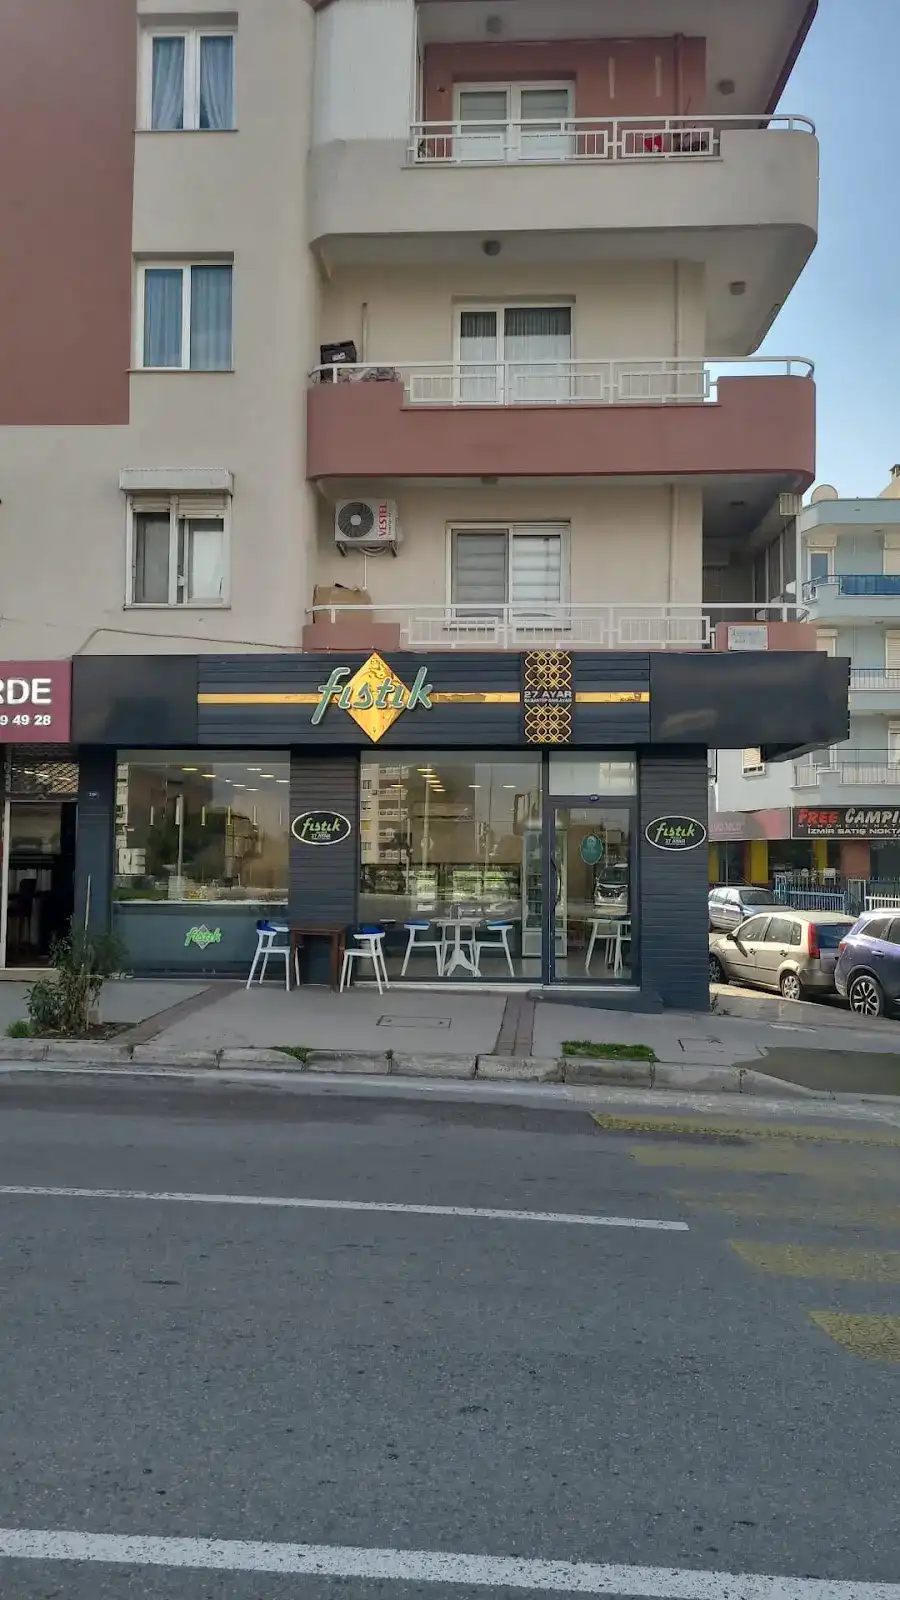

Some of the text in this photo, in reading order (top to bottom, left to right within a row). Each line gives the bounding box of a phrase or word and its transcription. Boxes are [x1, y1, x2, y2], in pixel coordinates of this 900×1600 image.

[379, 501, 388, 537] VESTEL
[0, 678, 52, 705] DE
[524, 690, 572, 699] 27 AYAR
[12, 714, 30, 726] 49
[34, 714, 52, 726] 28
[798, 808, 900, 824] FREE CAMPI
